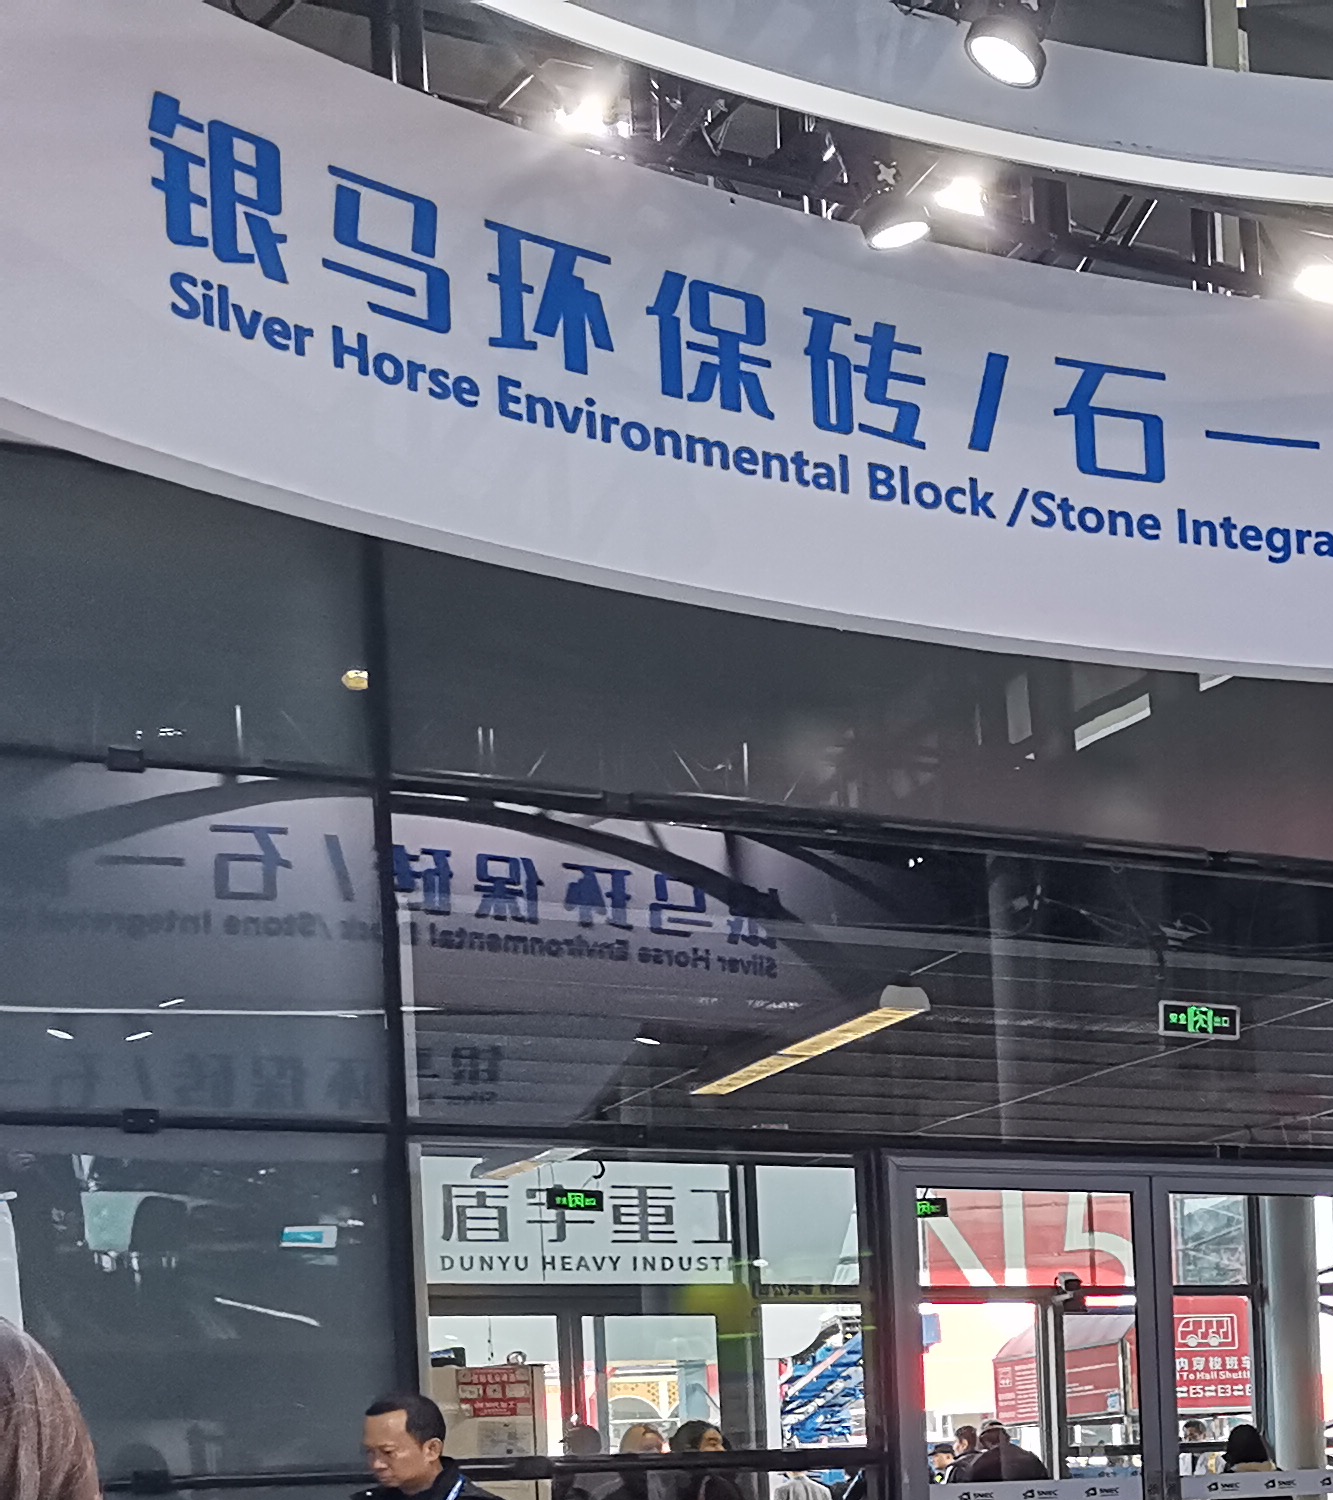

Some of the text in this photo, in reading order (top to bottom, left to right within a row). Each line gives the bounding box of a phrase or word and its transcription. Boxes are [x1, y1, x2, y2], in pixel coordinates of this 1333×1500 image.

[169, 271, 314, 357] Silver
[331, 324, 480, 408] Horse
[497, 376, 850, 495] Environmental
[868, 461, 997, 519] Block
[1006, 486, 1162, 541] /Stone
[440, 1255, 529, 1272] DUNYU
[542, 1256, 622, 1272] HEAVY
[1219, 1370, 1250, 1380] Shuttl
